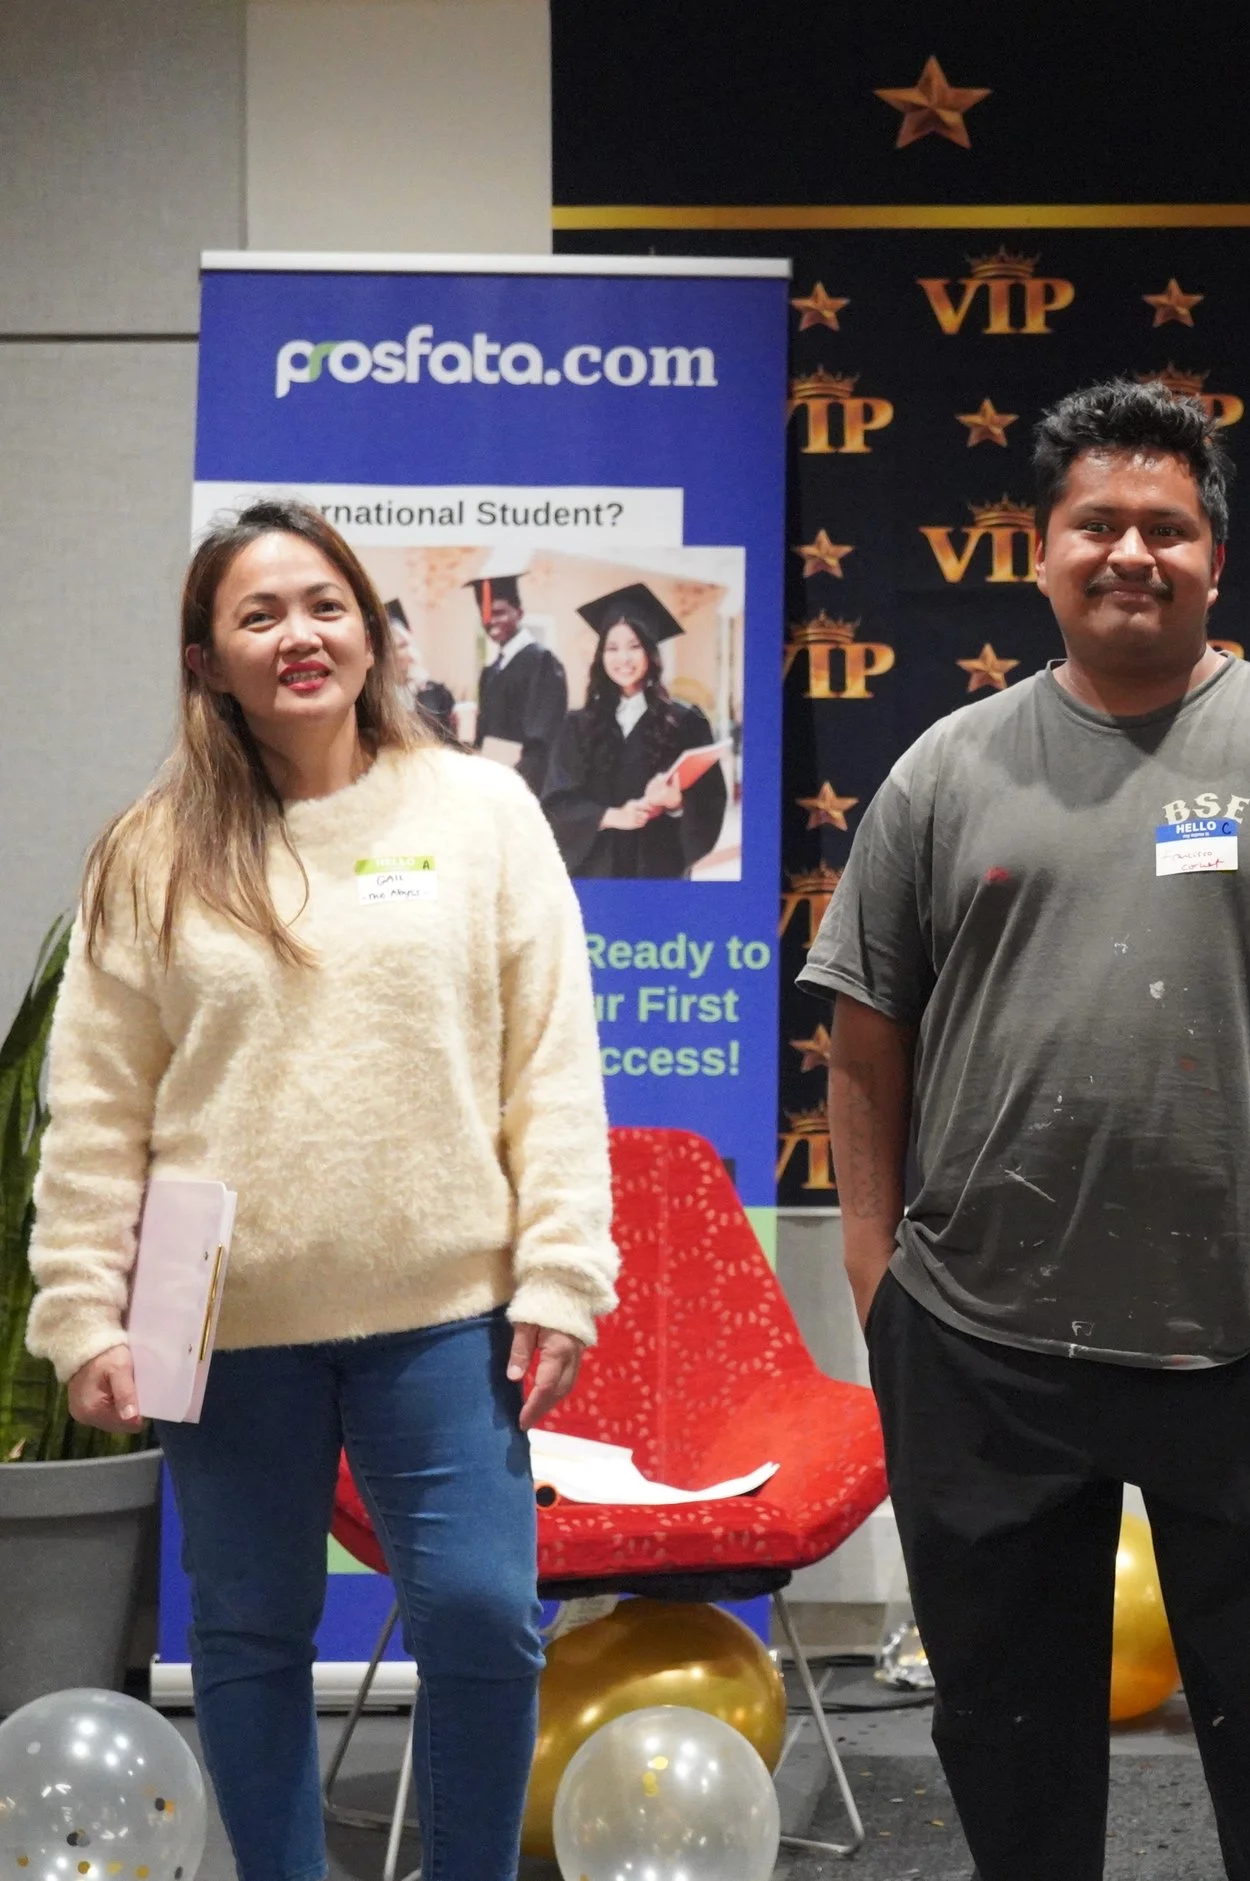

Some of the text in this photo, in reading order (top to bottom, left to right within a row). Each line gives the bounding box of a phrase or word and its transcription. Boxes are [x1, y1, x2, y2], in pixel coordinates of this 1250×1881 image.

[917, 278, 1075, 335] VIP
[275, 324, 719, 399] prosfata.com
[787, 397, 893, 454] IP
[320, 501, 624, 527] rnational Student?
[919, 526, 1038, 584] VI
[1175, 821, 1217, 834] HELLO
[1222, 822, 1232, 835] C
[586, 932, 771, 979] Ready to
[638, 986, 740, 1023] First
[601, 1040, 740, 1076] ccess!
